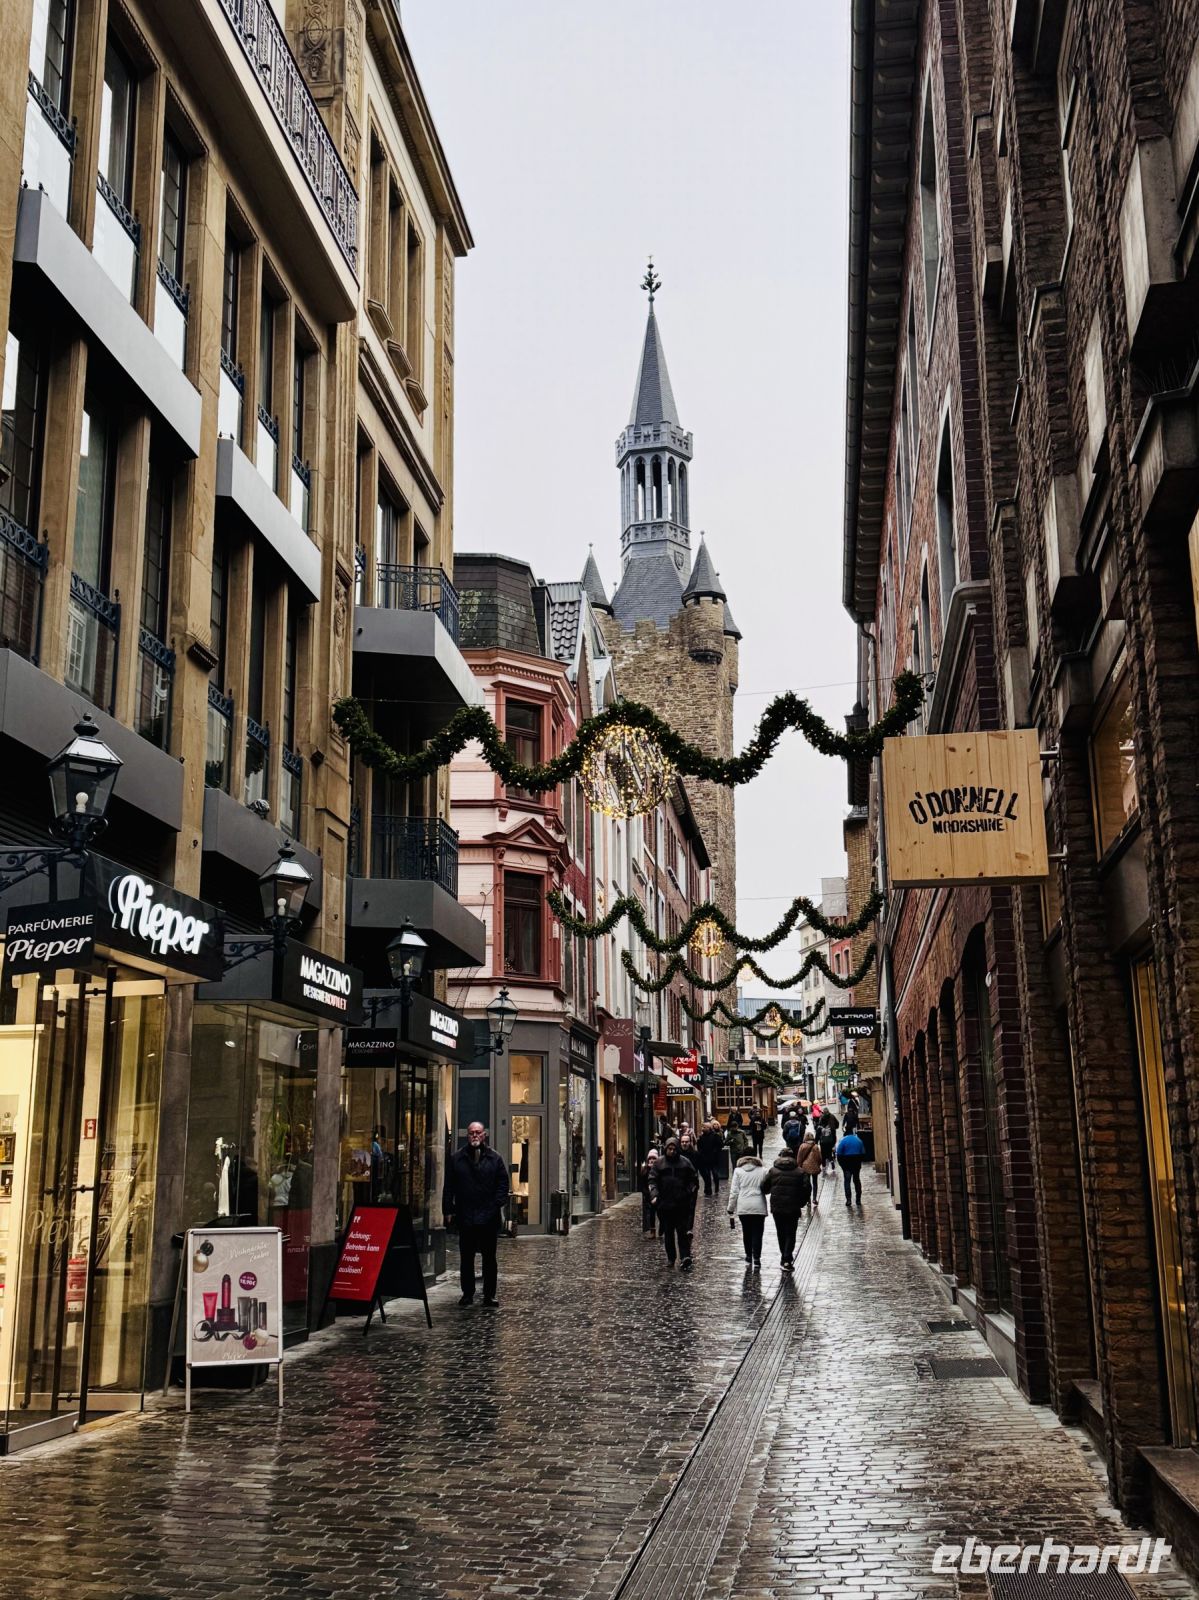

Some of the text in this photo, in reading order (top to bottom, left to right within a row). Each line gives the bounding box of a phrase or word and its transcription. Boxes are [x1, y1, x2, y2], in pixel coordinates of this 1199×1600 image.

[932, 818, 1005, 833] MOONSHINE
[110, 874, 210, 954] Pieper
[8, 915, 94, 935] PARFÜMERIE
[6, 937, 92, 962] Pieper
[300, 955, 351, 995] MAGAZZINO
[848, 1026, 874, 1036] mey
[348, 1041, 395, 1049] MAGAZZINO
[348, 1231, 371, 1241] Achtung:
[345, 1242, 380, 1252] Betreten kann
[341, 1253, 360, 1262] Freude
[338, 1264, 363, 1274] auslösen!
